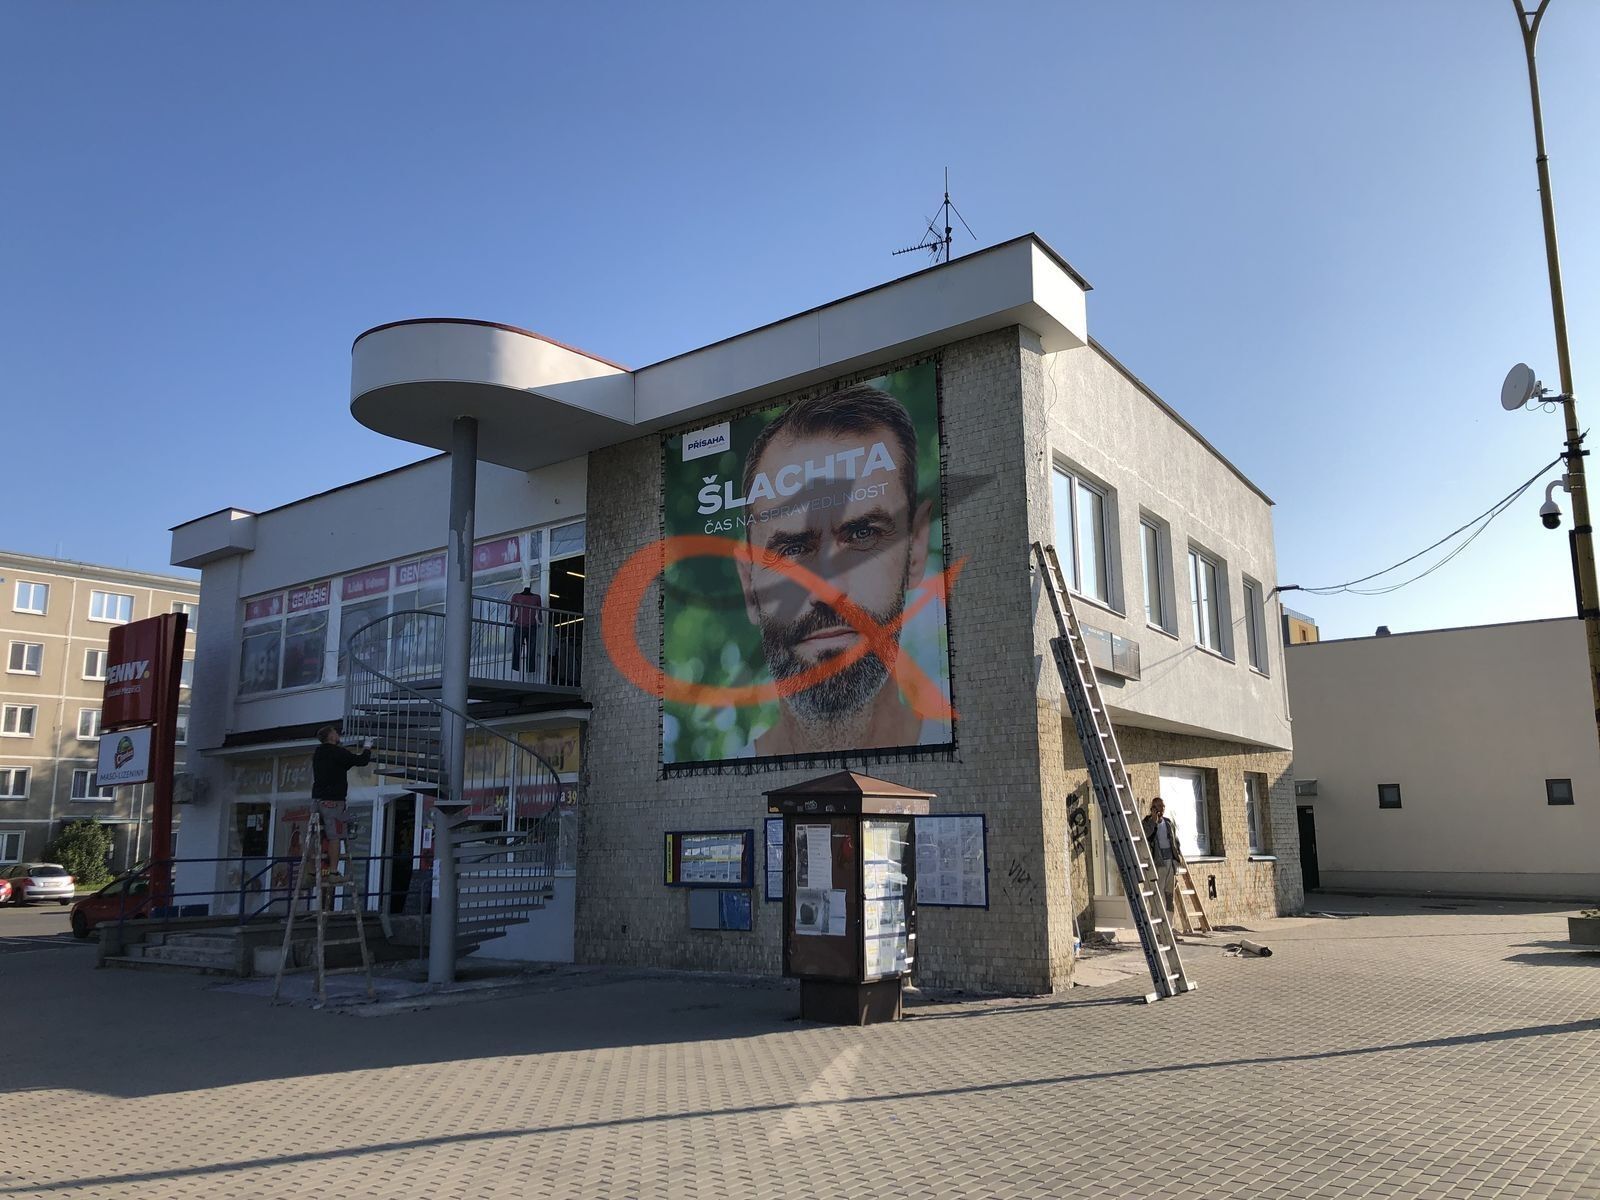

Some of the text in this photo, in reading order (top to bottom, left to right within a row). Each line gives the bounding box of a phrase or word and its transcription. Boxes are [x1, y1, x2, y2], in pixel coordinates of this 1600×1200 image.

[687, 435, 725, 451] PŘÍSAHA
[697, 441, 897, 515] ŠLACHTA
[704, 482, 889, 535] ČAS NA SPRAVEDLNOST
[399, 561, 442, 582] GENESIS
[291, 587, 328, 609] GENESIS
